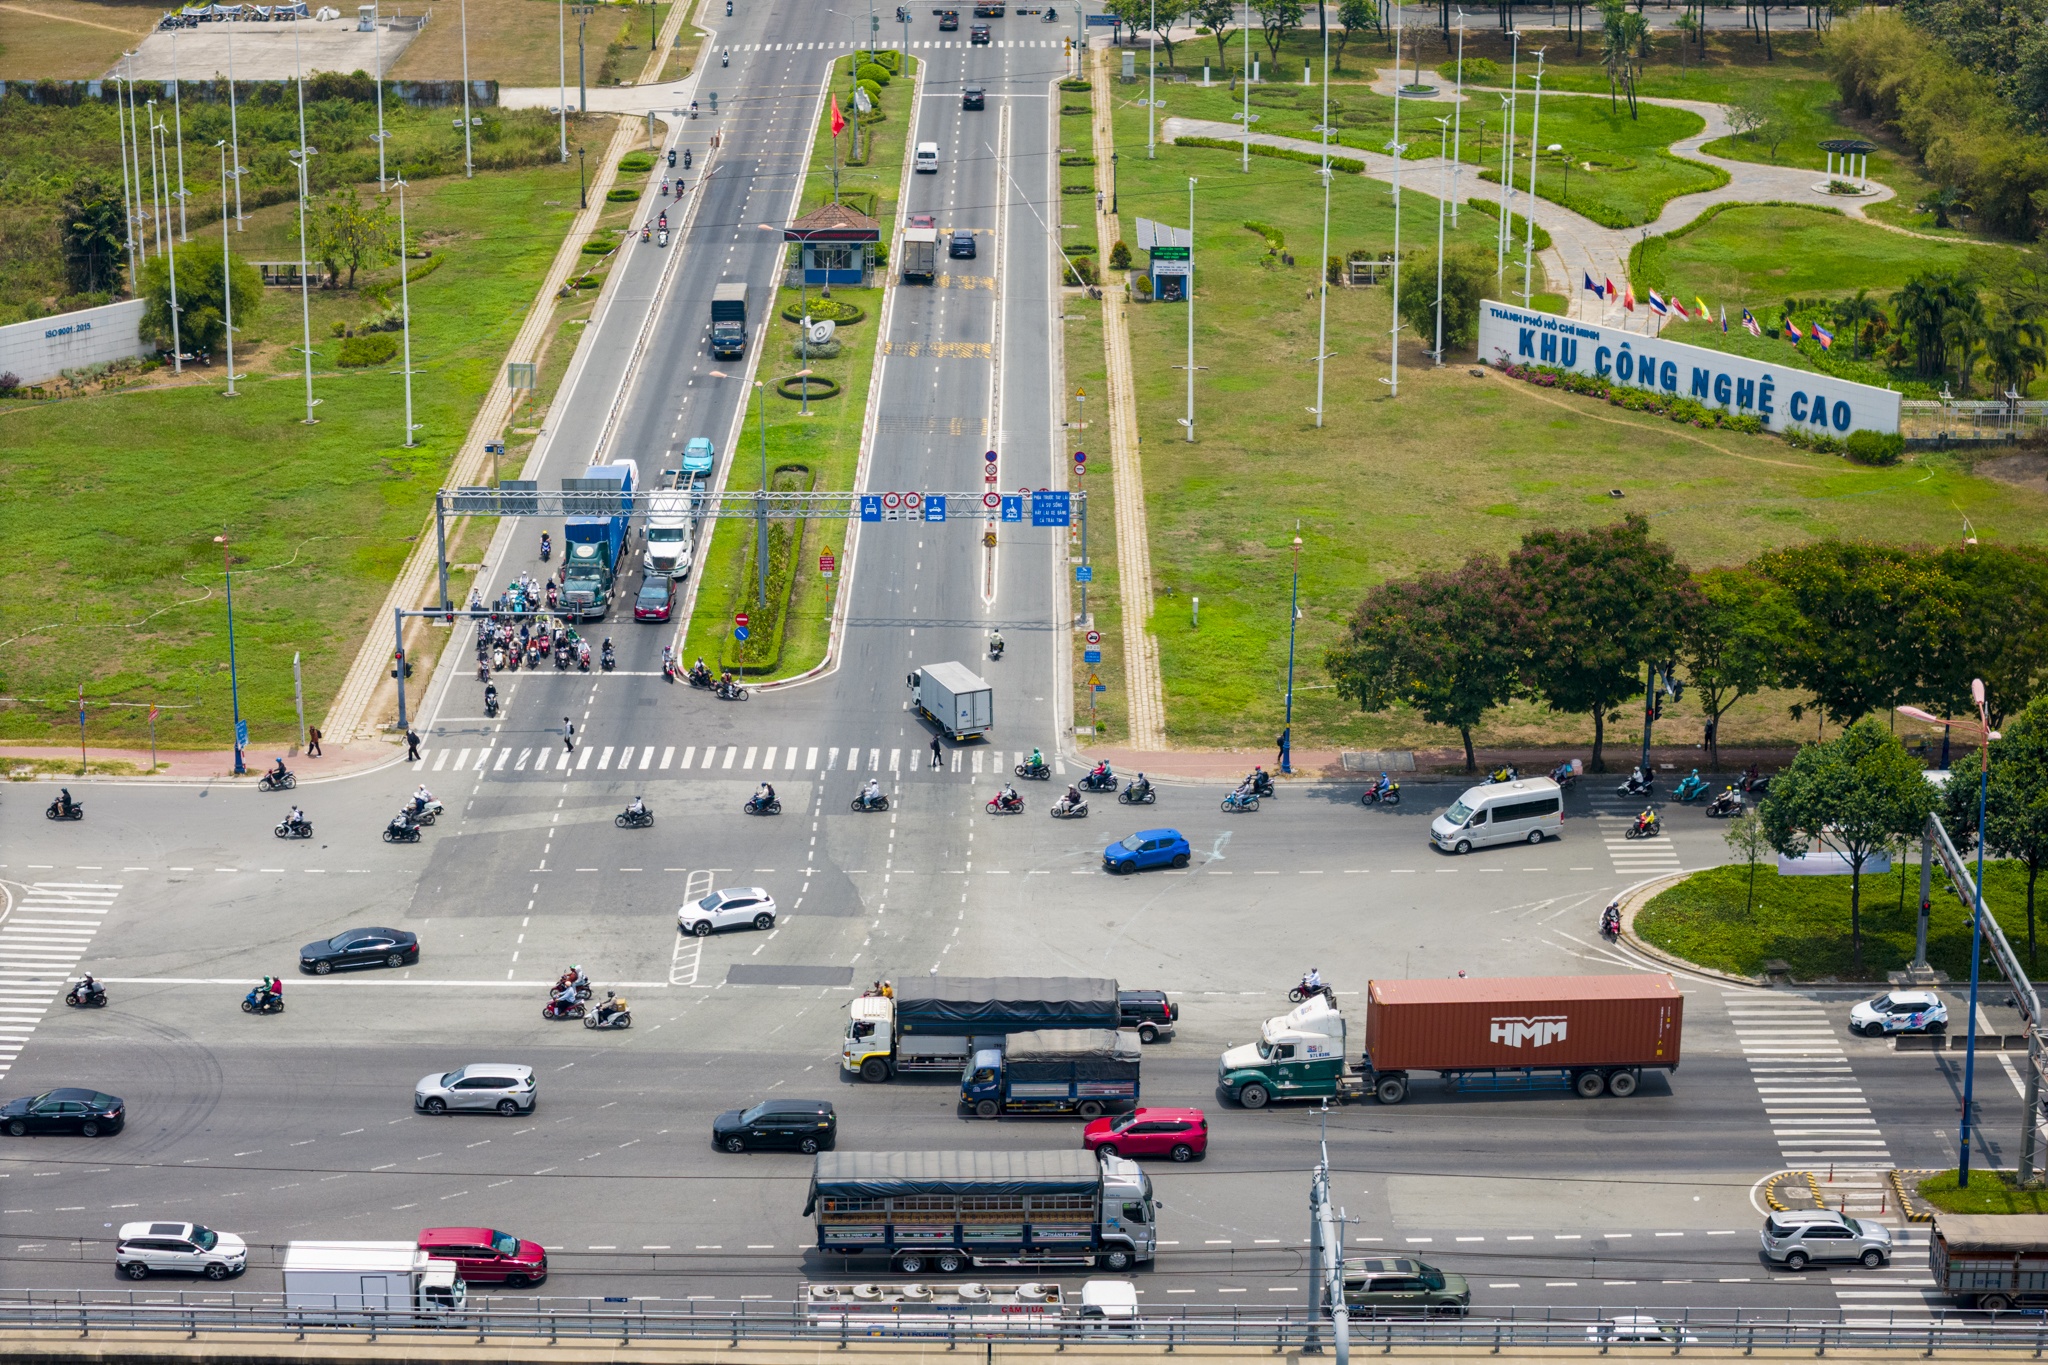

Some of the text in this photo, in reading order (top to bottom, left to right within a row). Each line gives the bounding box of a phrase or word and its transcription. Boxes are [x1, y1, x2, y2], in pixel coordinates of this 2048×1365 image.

[45, 329, 57, 338] ISO
[1490, 308, 1600, 341] THÀNH PHỐ HỒ CHÍ MINH
[1519, 327, 1851, 431] KHU CÔNG NGHỆ CAO
[888, 496, 896, 504] 40
[908, 496, 916, 504] 60
[1490, 1016, 1568, 1048] HMM
